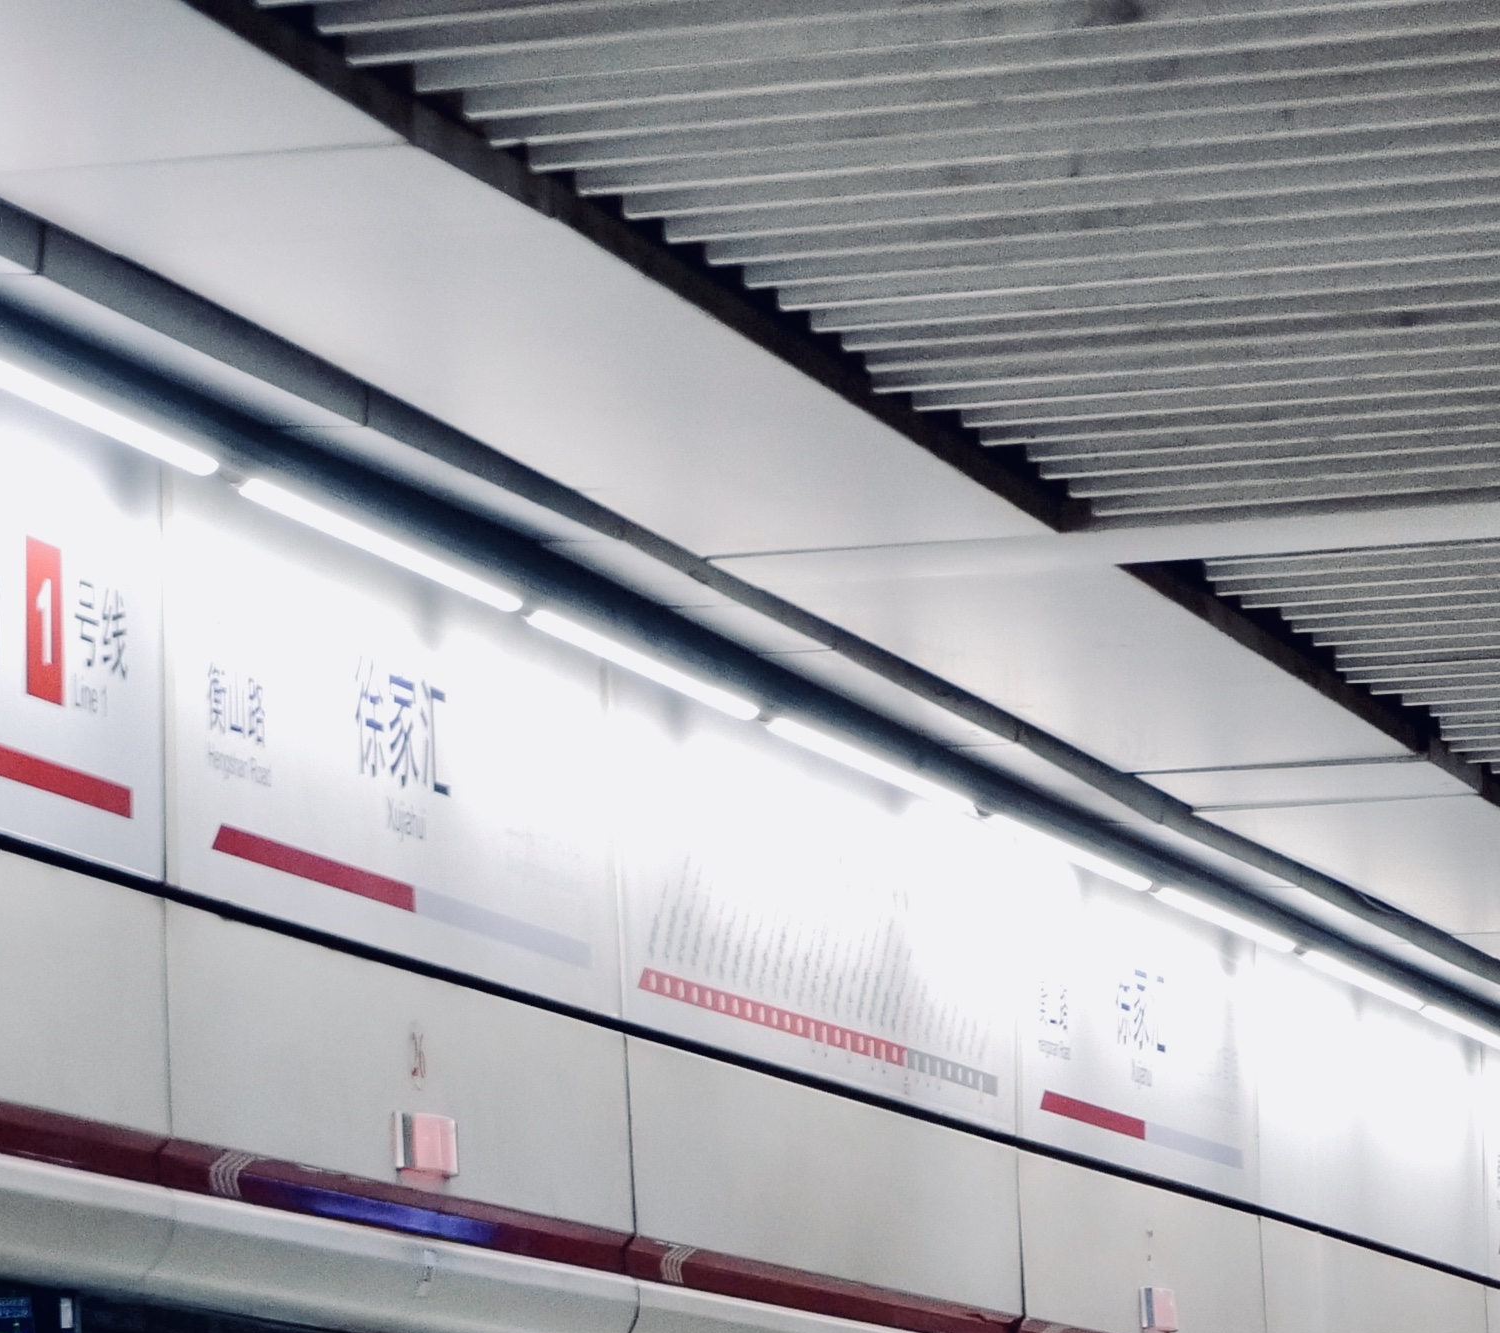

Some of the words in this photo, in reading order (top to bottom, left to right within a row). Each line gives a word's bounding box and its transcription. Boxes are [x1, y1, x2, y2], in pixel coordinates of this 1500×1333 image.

[207, 661, 266, 748] 衡山路
[355, 655, 451, 797] 徐家汇
